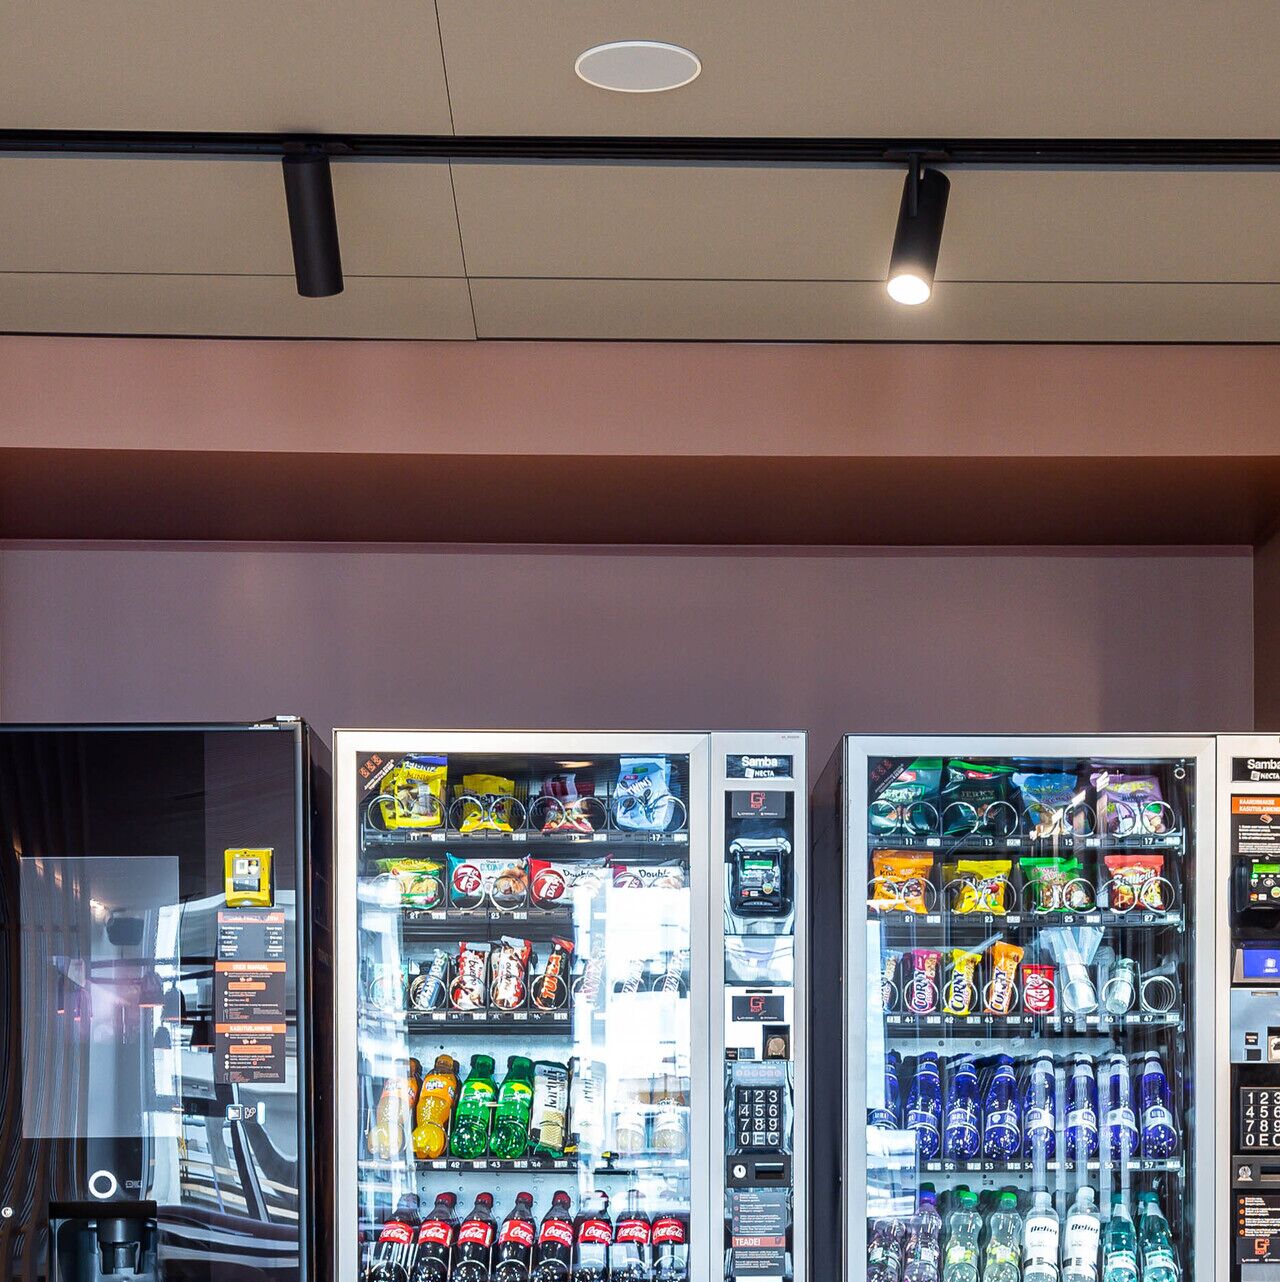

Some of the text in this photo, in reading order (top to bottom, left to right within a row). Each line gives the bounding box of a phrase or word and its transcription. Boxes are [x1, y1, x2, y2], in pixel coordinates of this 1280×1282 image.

[741, 756, 778, 767] Samba
[1260, 772, 1280, 780] NECTA
[628, 776, 652, 795] TWINS
[1065, 838, 1073, 846] 15
[913, 970, 929, 1010] CORNY
[949, 970, 966, 1011] CORNY
[743, 1090, 778, 1103] 1 2 3
[1248, 1092, 1254, 1105] 1
[1260, 1092, 1269, 1105] 2
[741, 1105, 778, 1117] 4 5 6
[1245, 1106, 1255, 1118] 4
[1260, 1106, 1269, 1118] 5
[741, 1119, 778, 1131] 7 8 9
[1245, 1120, 1255, 1132] 7
[1260, 1120, 1269, 1132] 8
[741, 1132, 779, 1145] 0 E C
[1245, 1134, 1255, 1146] 0
[1259, 1134, 1269, 1146] E
